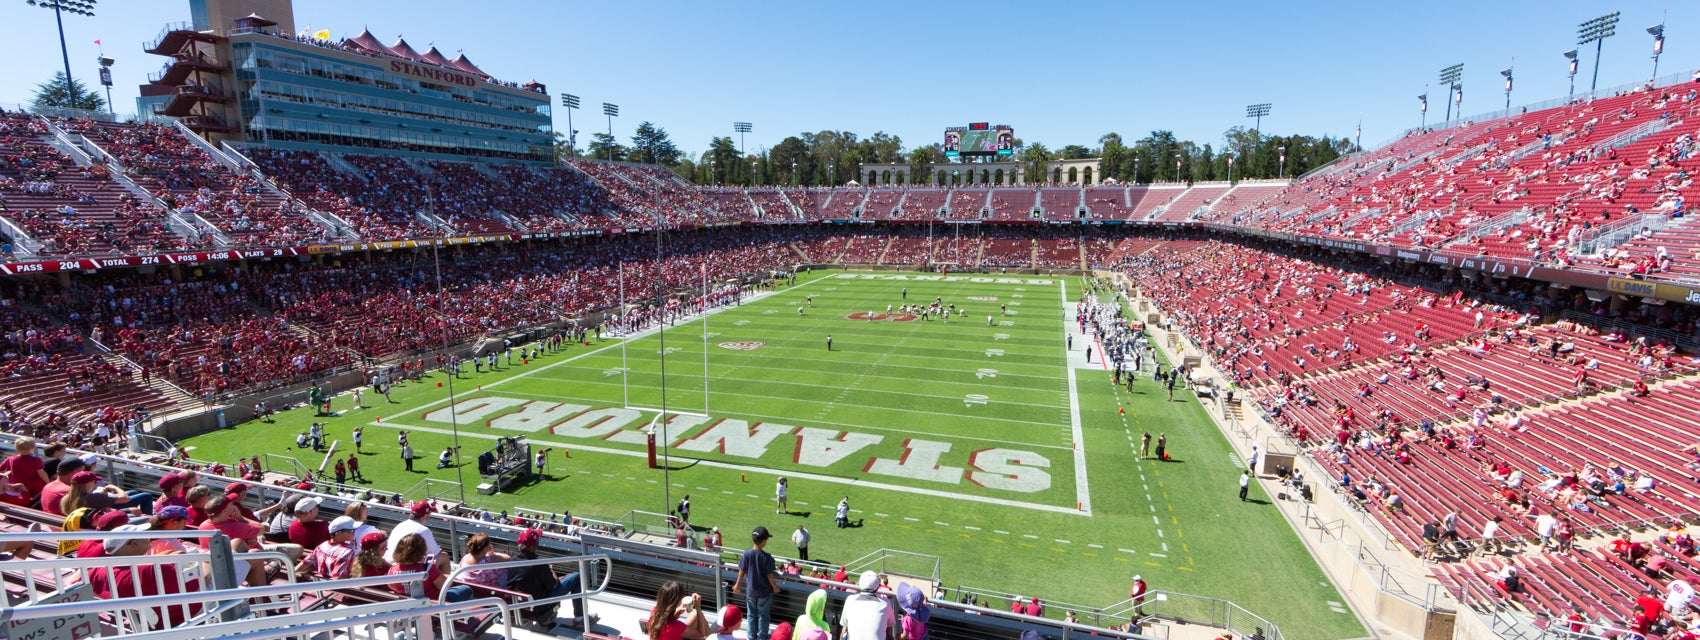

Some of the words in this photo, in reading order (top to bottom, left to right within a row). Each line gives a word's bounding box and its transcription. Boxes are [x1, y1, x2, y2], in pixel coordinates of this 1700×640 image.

[390, 60, 476, 87] STANFORD
[102, 259, 128, 267] TOTAL
[141, 256, 160, 265] 274
[206, 252, 229, 260] 14:06
[16, 263, 43, 272] PASS
[59, 261, 80, 270] 204
[1685, 289, 1700, 303] Je
[421, 396, 1051, 493] STANFORD
